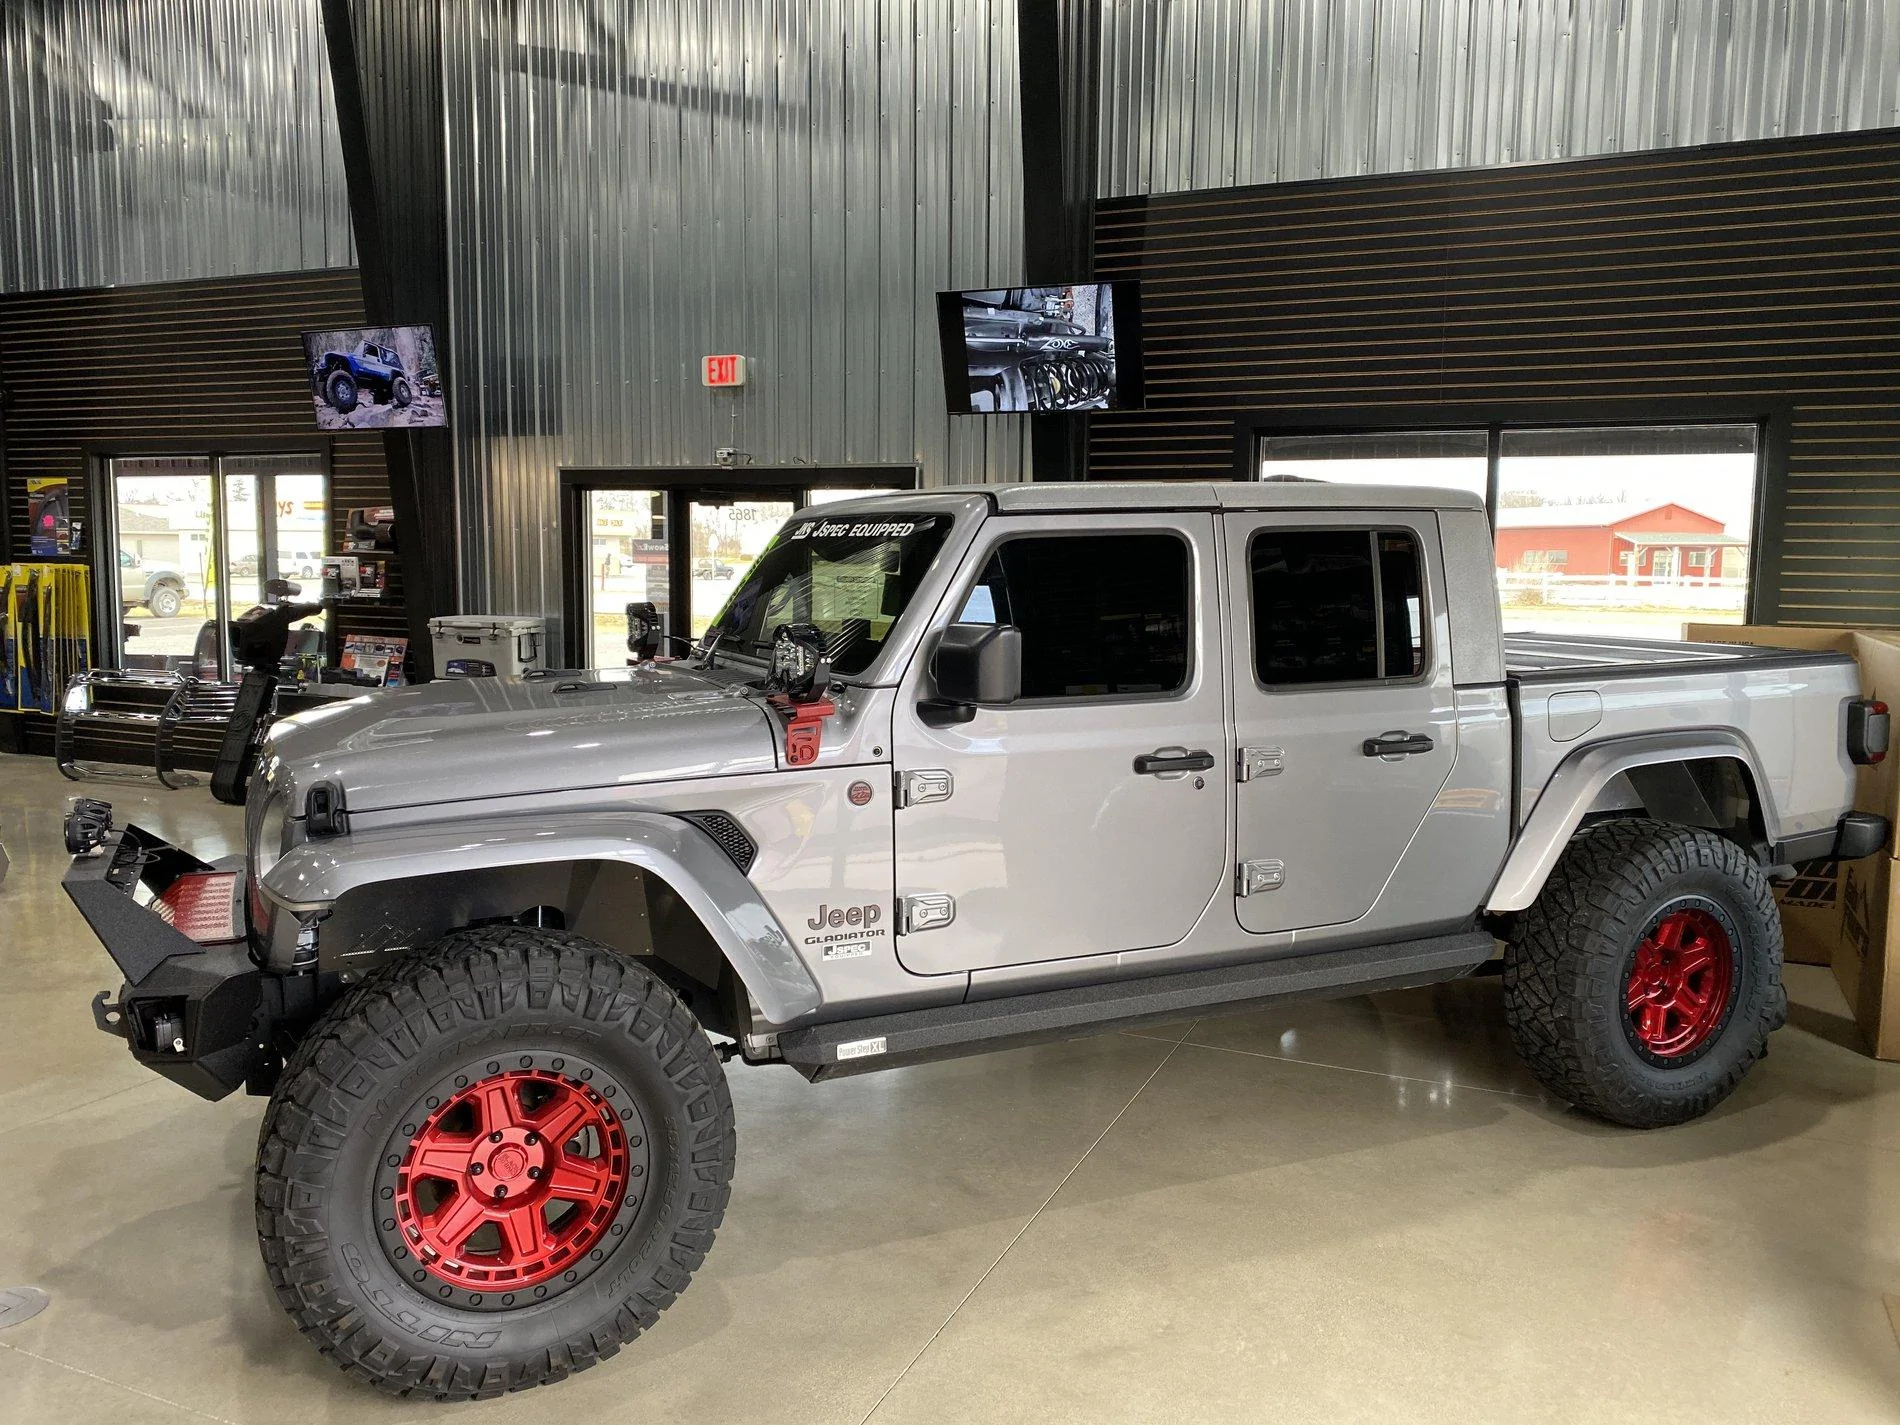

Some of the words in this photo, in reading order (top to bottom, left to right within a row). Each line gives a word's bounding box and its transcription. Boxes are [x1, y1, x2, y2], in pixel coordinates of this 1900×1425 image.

[708, 356, 737, 384] EXIT
[848, 523, 915, 537] EQUIPPED
[808, 904, 881, 930] Jeep
[804, 929, 886, 945] GLADIATOR
[827, 943, 867, 956] JSPEC
[870, 1040, 886, 1053] XL
[341, 1243, 502, 1349] NITTO
